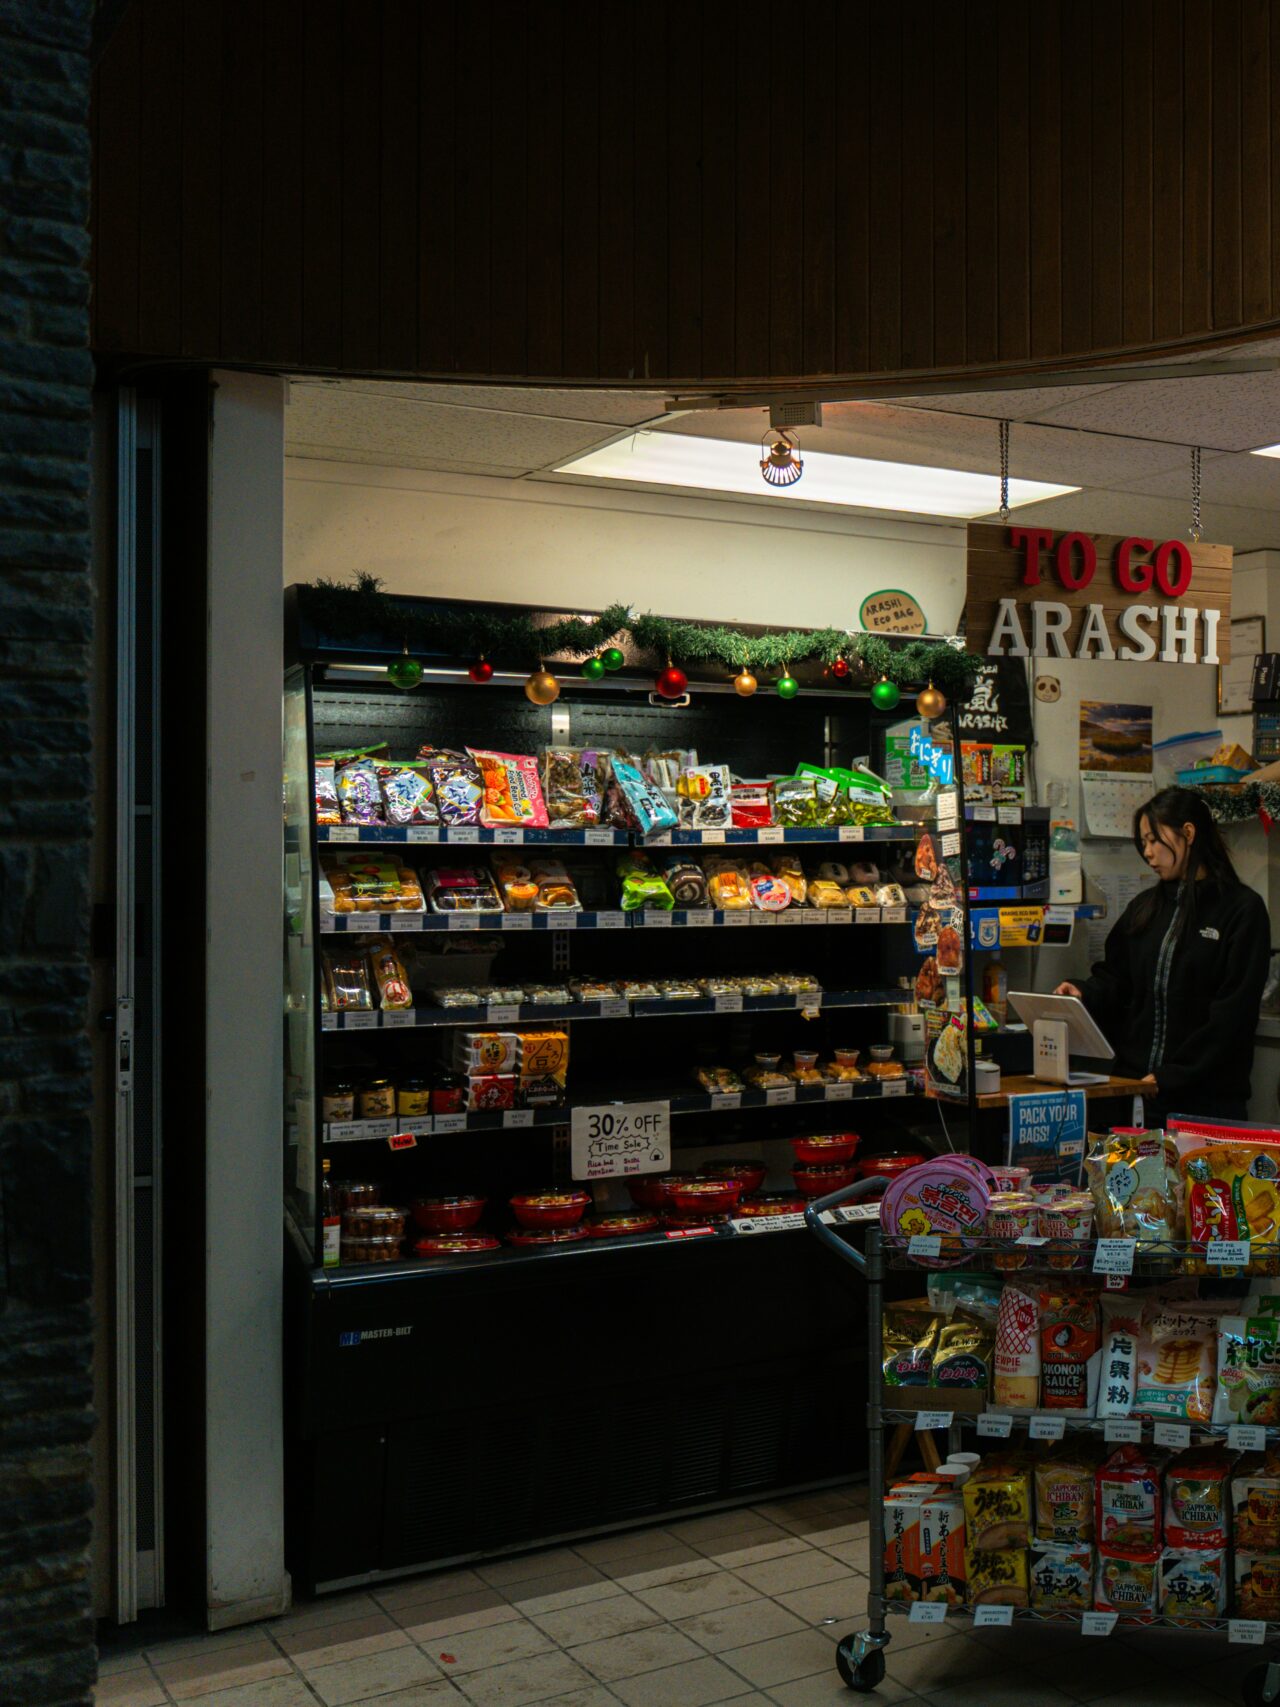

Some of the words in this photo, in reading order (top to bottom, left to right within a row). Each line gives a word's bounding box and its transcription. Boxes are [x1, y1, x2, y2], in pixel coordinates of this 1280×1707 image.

[1010, 527, 1097, 591] TO
[1116, 536, 1193, 597] GO
[865, 598, 902, 617] ARASHI
[873, 616, 891, 627] ECO
[893, 608, 914, 621] BAG
[987, 598, 1221, 664] ARASHI
[910, 729, 952, 782] おにぎり
[1019, 1106, 1047, 1125] PACK
[1049, 1104, 1078, 1122] YOUR
[588, 1113, 629, 1139] 30%
[634, 1114, 662, 1133] OFF
[1019, 1125, 1050, 1144] BAGS!
[595, 1142, 619, 1152] Time
[624, 1140, 641, 1150] Sale
[361, 1325, 413, 1340] MASTER-BILT
[995, 1357, 1021, 1366] EWPIE
[1044, 1375, 1080, 1387] SAUCE
[1051, 1484, 1082, 1492] SAPPORO
[1046, 1491, 1084, 1502] ICHIBAN
[1116, 1493, 1142, 1501] SAPPORO
[1111, 1500, 1144, 1509] ICHIBAN
[1187, 1503, 1216, 1511] SAPPORO
[1181, 1510, 1219, 1522] ICHIBAN
[1115, 1583, 1146, 1592] SAPPORO
[1110, 1592, 1148, 1603] ICHIBAN
